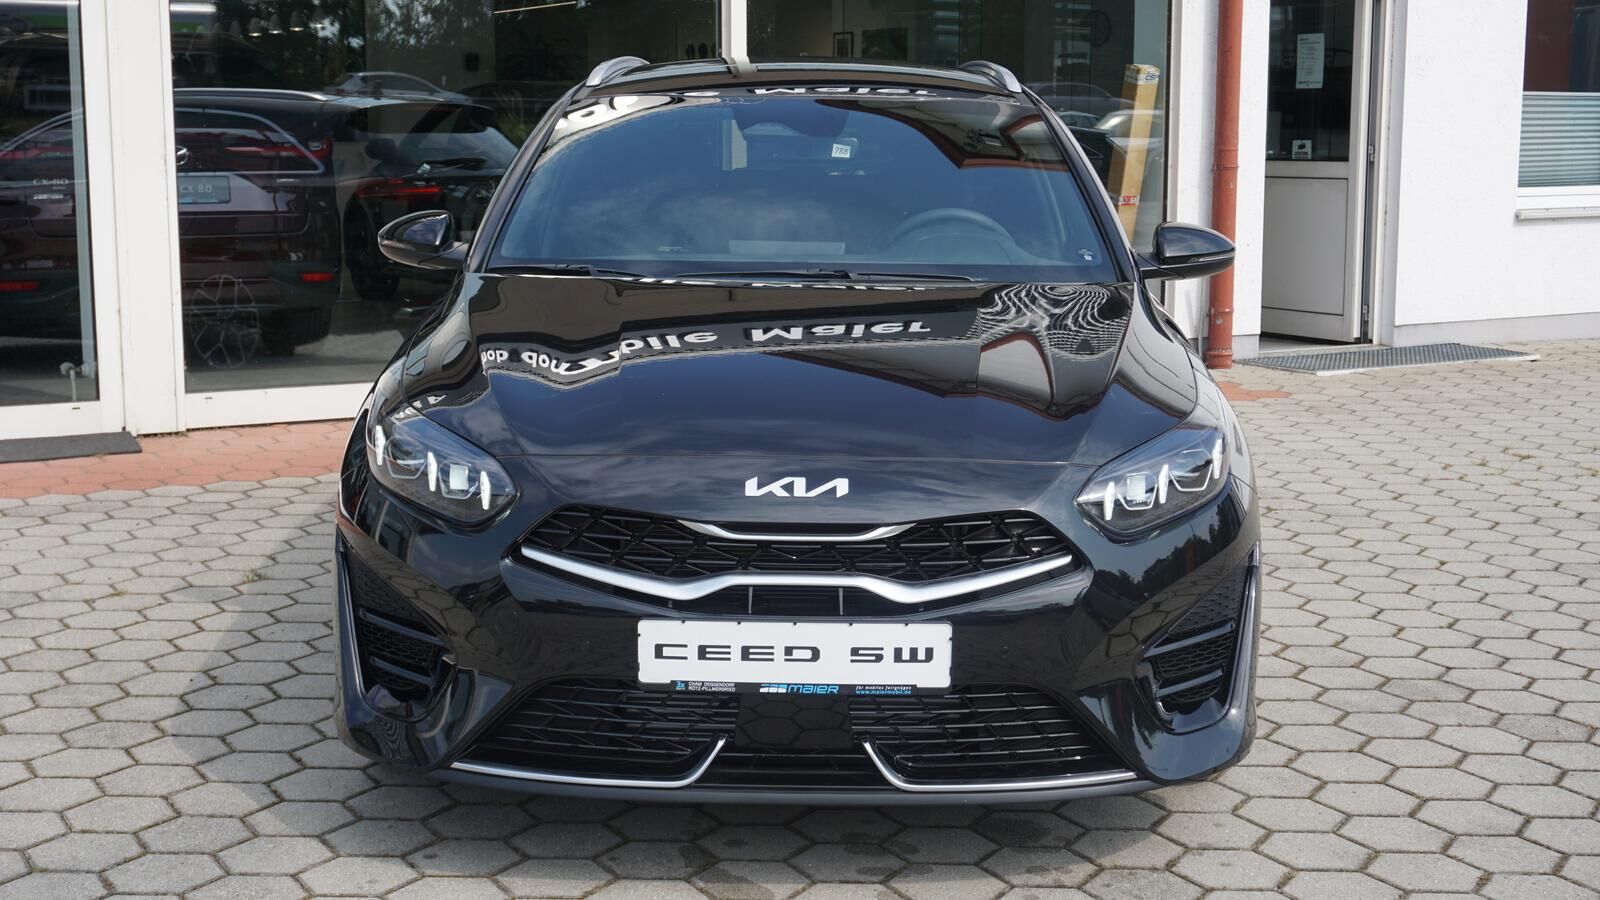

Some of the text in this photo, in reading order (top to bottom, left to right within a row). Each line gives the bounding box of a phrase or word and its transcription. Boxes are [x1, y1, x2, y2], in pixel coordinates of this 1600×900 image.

[745, 476, 849, 498] KIA
[654, 643, 934, 663] CEED SW
